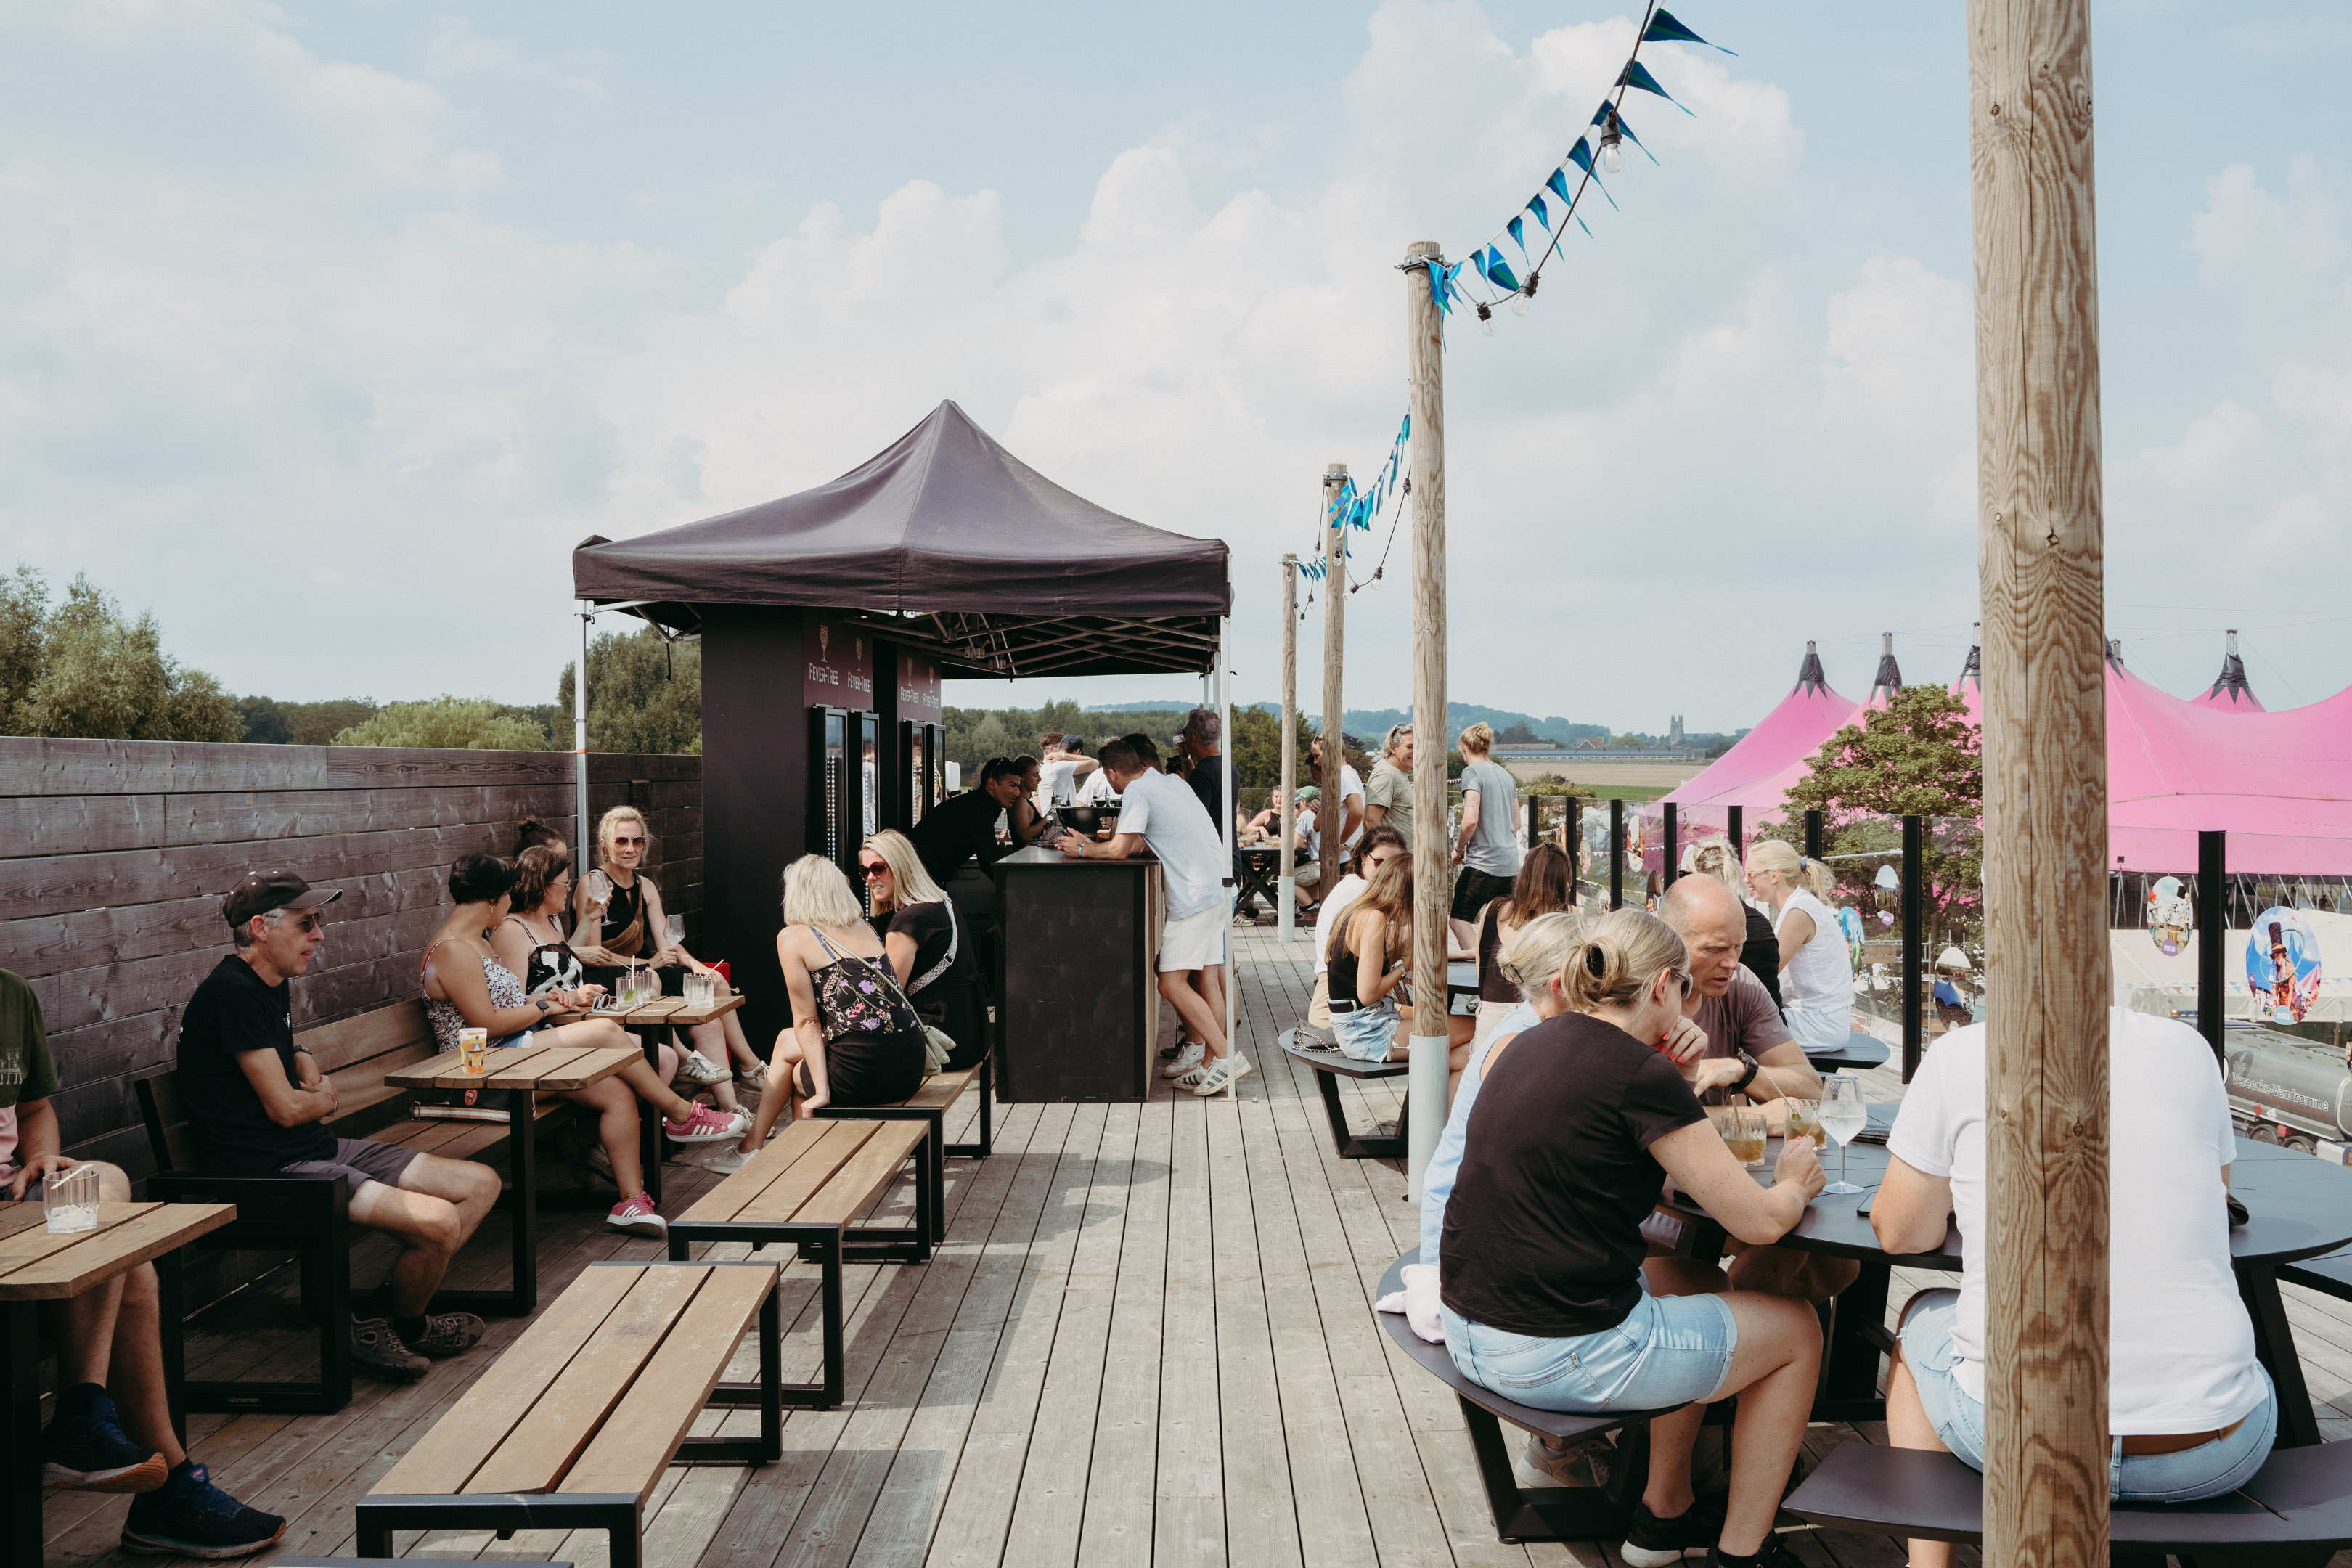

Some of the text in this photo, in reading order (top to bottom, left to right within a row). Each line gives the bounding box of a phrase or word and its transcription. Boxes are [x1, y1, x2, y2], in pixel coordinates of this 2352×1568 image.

[809, 662, 839, 685] FEVER-TREE
[847, 671, 870, 693] FEVER-TREE
[2231, 1071, 2329, 1111] Vereecke-Vandromme
